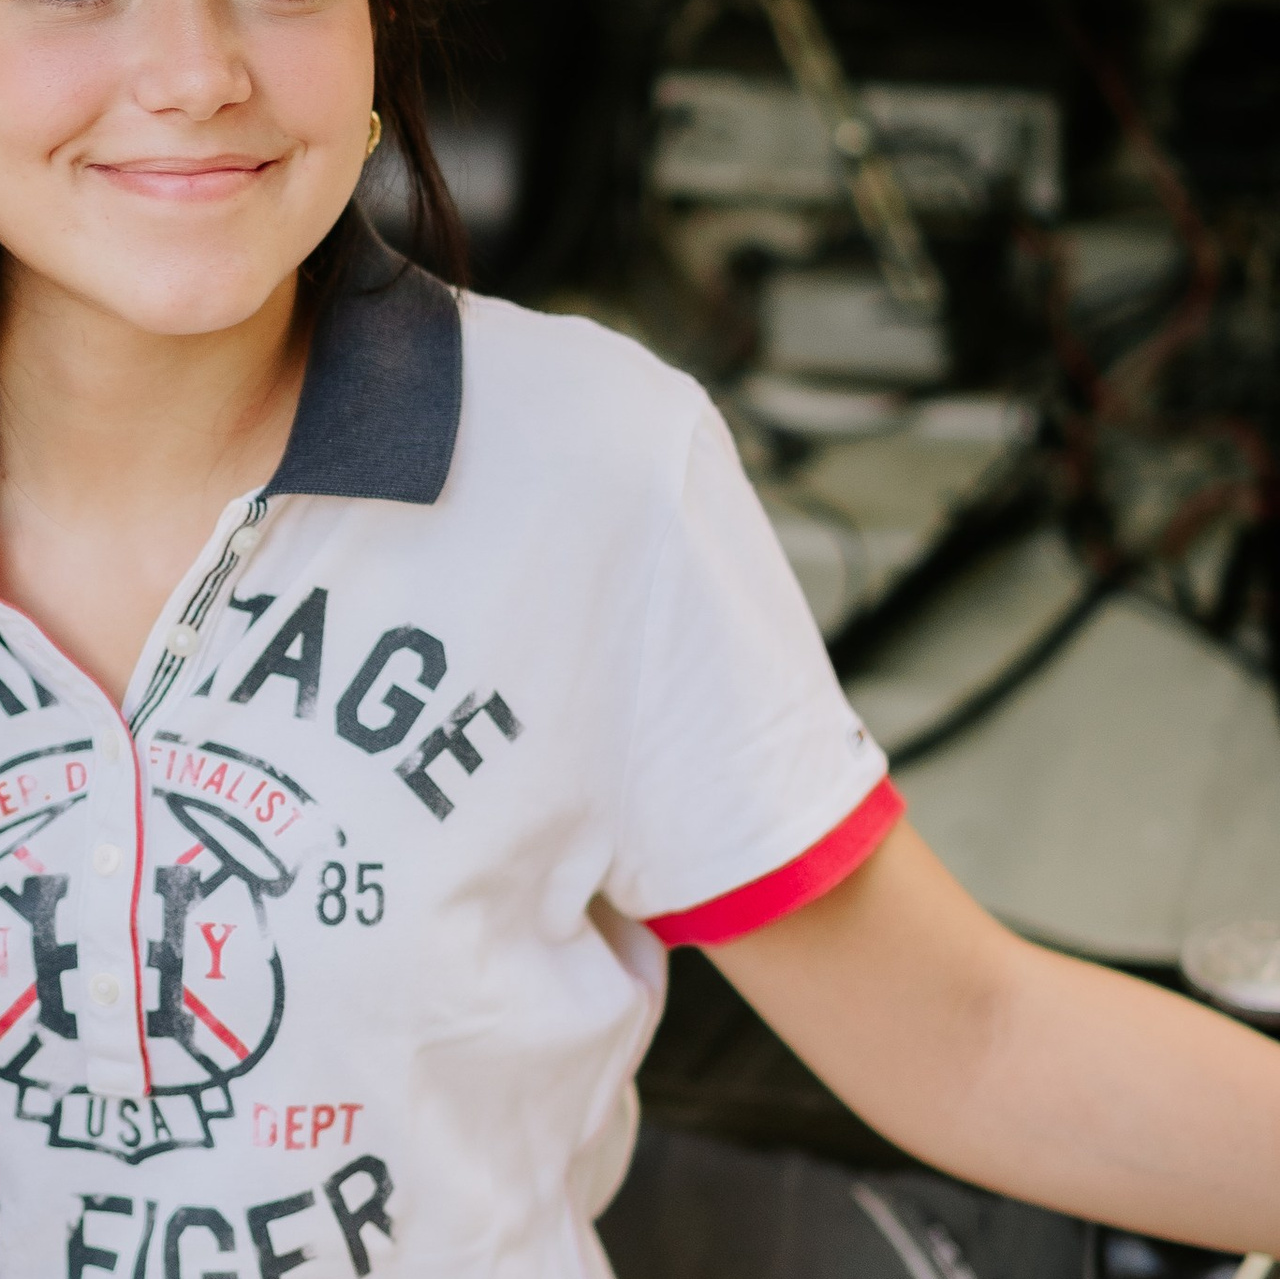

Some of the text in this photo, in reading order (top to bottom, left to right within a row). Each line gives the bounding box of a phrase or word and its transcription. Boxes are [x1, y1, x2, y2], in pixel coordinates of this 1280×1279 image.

[195, 922, 238, 981] Y
[87, 1096, 173, 1148] USA
[253, 1103, 364, 1151] DEPT
